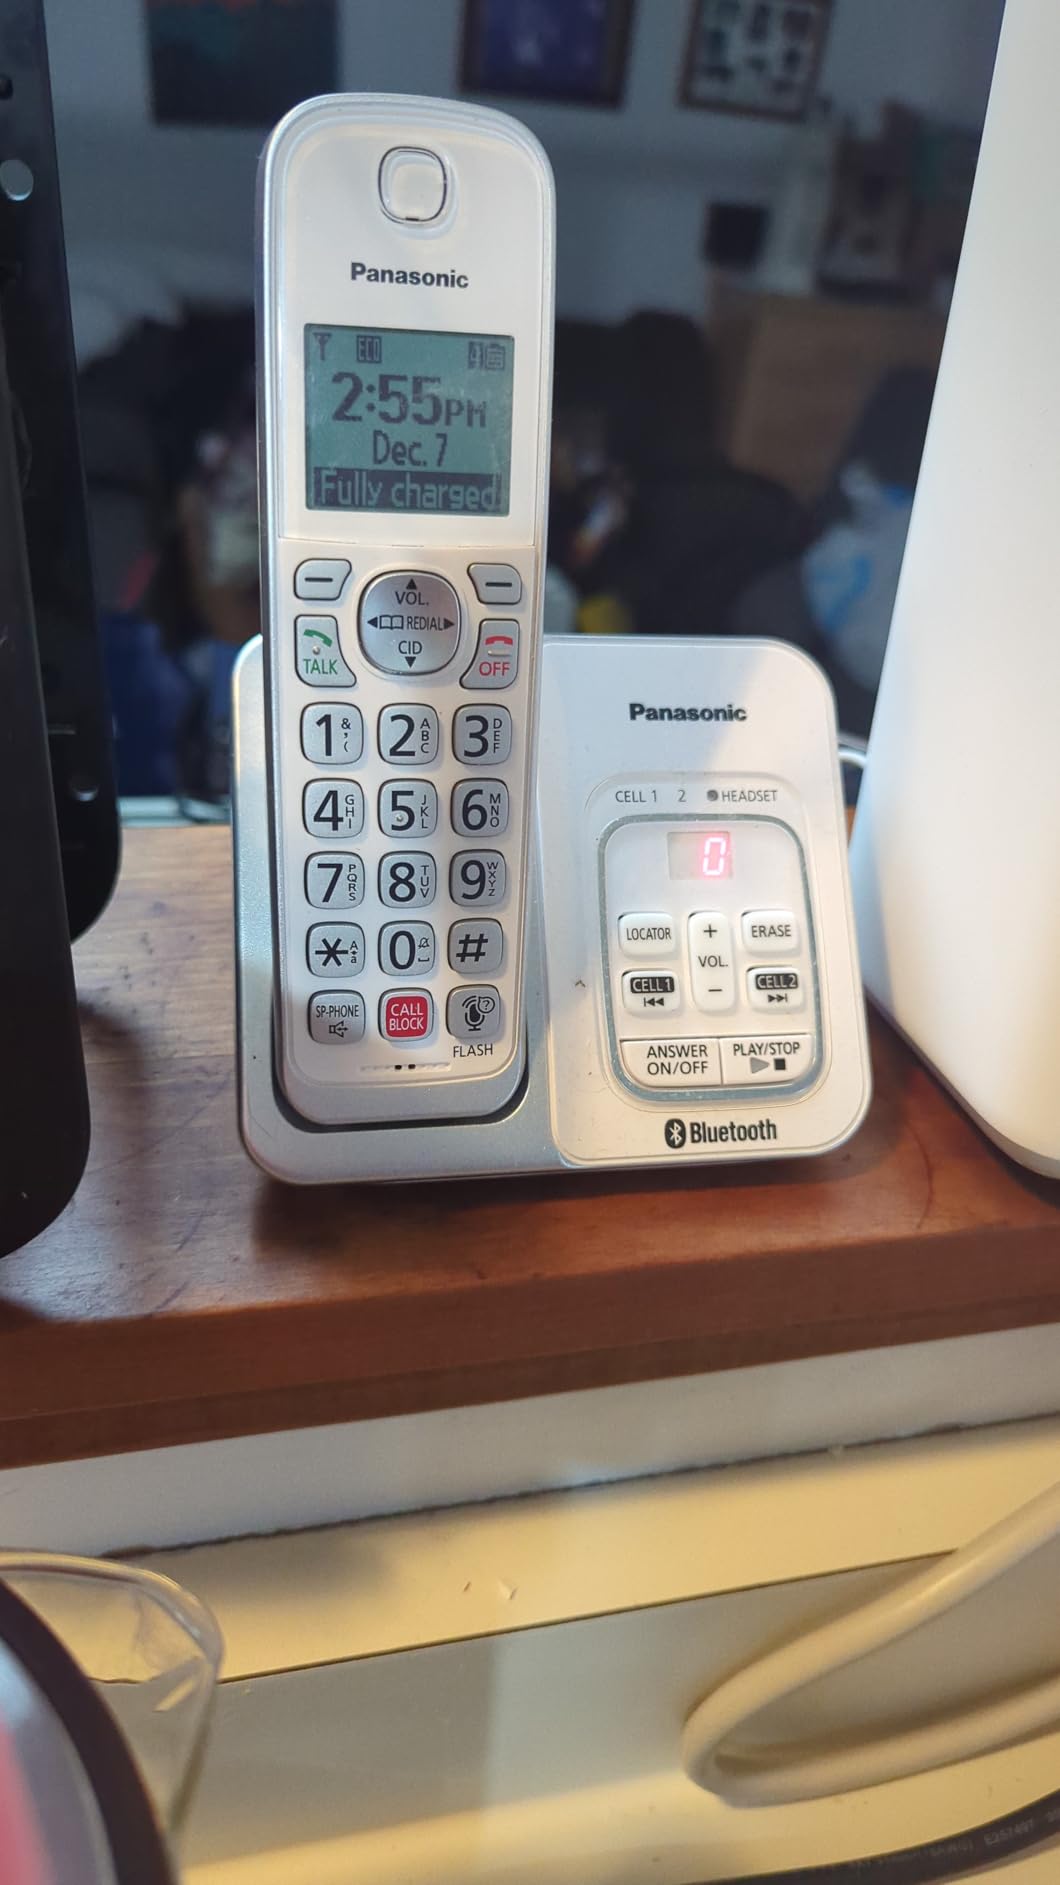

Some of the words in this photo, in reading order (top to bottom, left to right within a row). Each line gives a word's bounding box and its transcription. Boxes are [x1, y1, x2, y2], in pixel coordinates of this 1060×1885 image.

[351, 262, 469, 288] Panasonic
[358, 337, 380, 361] ECO
[320, 469, 383, 505] Fully
[391, 472, 497, 510] charged
[395, 591, 430, 606] VOL.
[406, 616, 444, 631] REDIAL
[398, 640, 423, 655] CID
[303, 659, 338, 675] TALK
[479, 662, 510, 676] OFF
[629, 703, 748, 721] Panasonic
[315, 714, 332, 757] 1
[389, 714, 416, 757] 2
[463, 715, 489, 758] 3
[615, 790, 646, 803] CELL
[651, 790, 657, 803] 1
[677, 790, 687, 802] 2
[721, 790, 778, 802] HEADSET
[313, 790, 344, 831] 4
[391, 790, 415, 831] 5
[462, 789, 488, 830] 6
[702, 836, 727, 876] 0
[317, 863, 343, 903] 7
[389, 861, 416, 902] 8
[460, 859, 486, 900] 9
[626, 926, 672, 941] LOCATOR
[751, 924, 792, 937] ERASE
[389, 930, 416, 970] 0
[698, 955, 729, 968] VOL.
[315, 1004, 360, 1019] SP-PHONE
[390, 1003, 424, 1017] CALL
[389, 1017, 424, 1031] BLOCK
[453, 1043, 494, 1058] FLASH
[646, 1044, 708, 1059] ANSWER
[733, 1042, 800, 1056] PLAY/STOP
[646, 1061, 708, 1075] ON/OFF
[690, 1119, 777, 1144] Bluetooth
